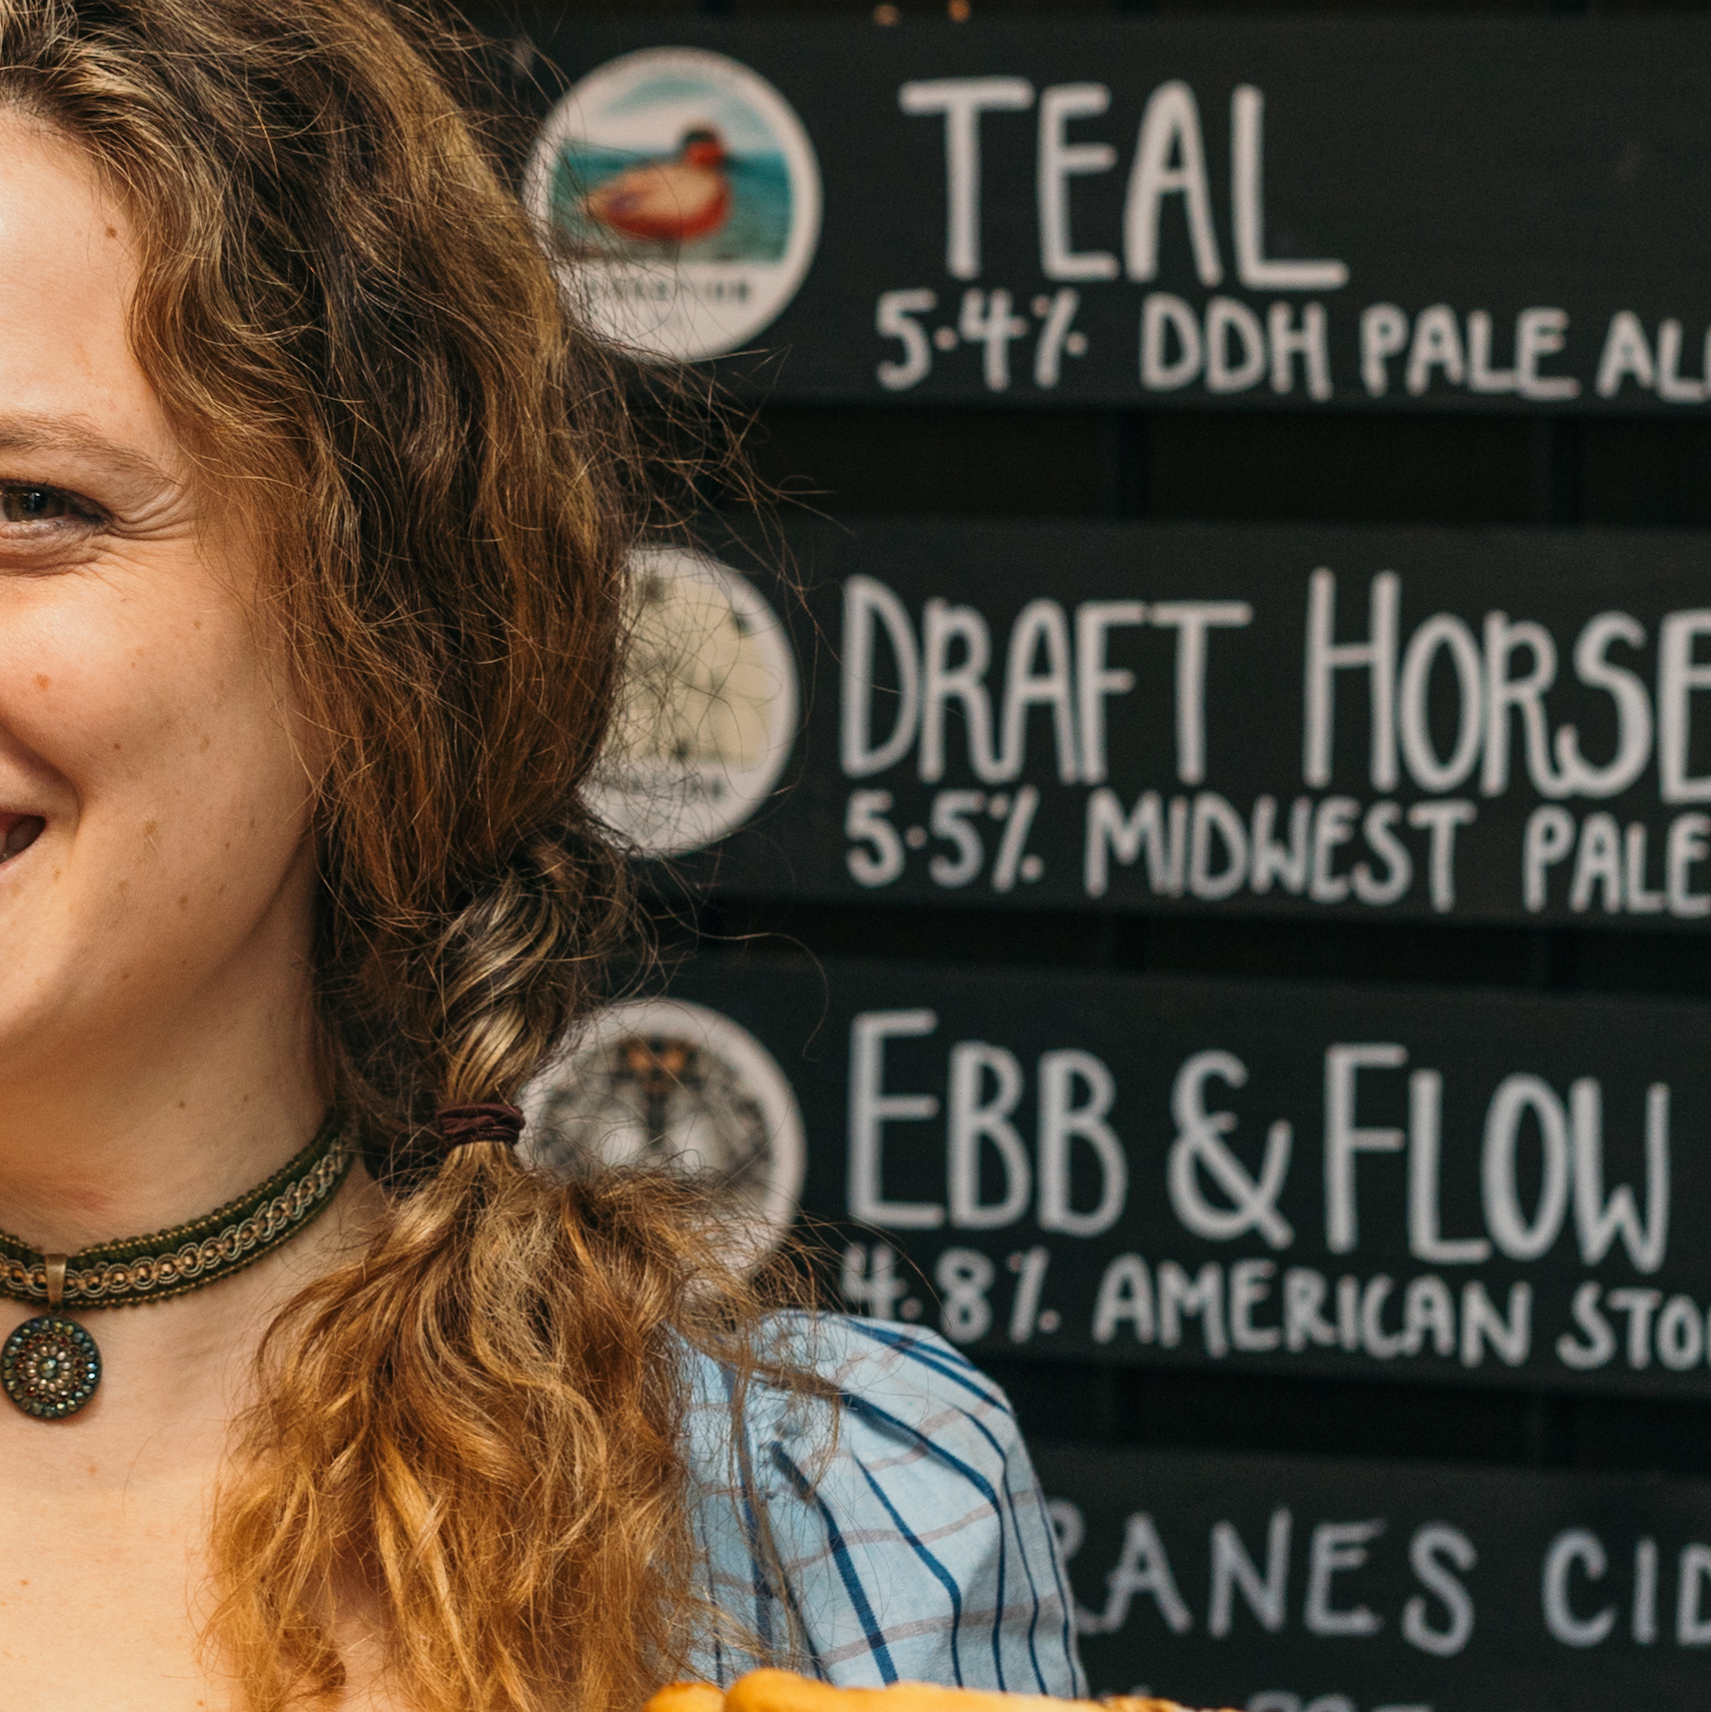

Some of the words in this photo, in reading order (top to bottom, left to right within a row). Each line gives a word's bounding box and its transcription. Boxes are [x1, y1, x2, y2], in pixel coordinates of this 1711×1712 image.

[897, 75, 1350, 292] TEAL
[875, 288, 1088, 391] 5.4%
[1139, 292, 1332, 401] DDH
[1359, 302, 1578, 401] PALE
[1595, 309, 1711, 403] AL
[840, 574, 1253, 786] DRAFT
[1302, 567, 1711, 806] HORSE
[845, 786, 1043, 891] 5.5%
[1083, 787, 1476, 913] MIDWEST
[1522, 804, 1711, 918] PALE
[847, 1009, 1128, 1237] EBB
[1167, 1050, 1293, 1249] &
[1324, 1042, 1671, 1274] FLOW
[843, 1244, 1058, 1341] 4.8%
[1092, 1254, 1532, 1367] AMERICAN
[1556, 1282, 1711, 1370] STO
